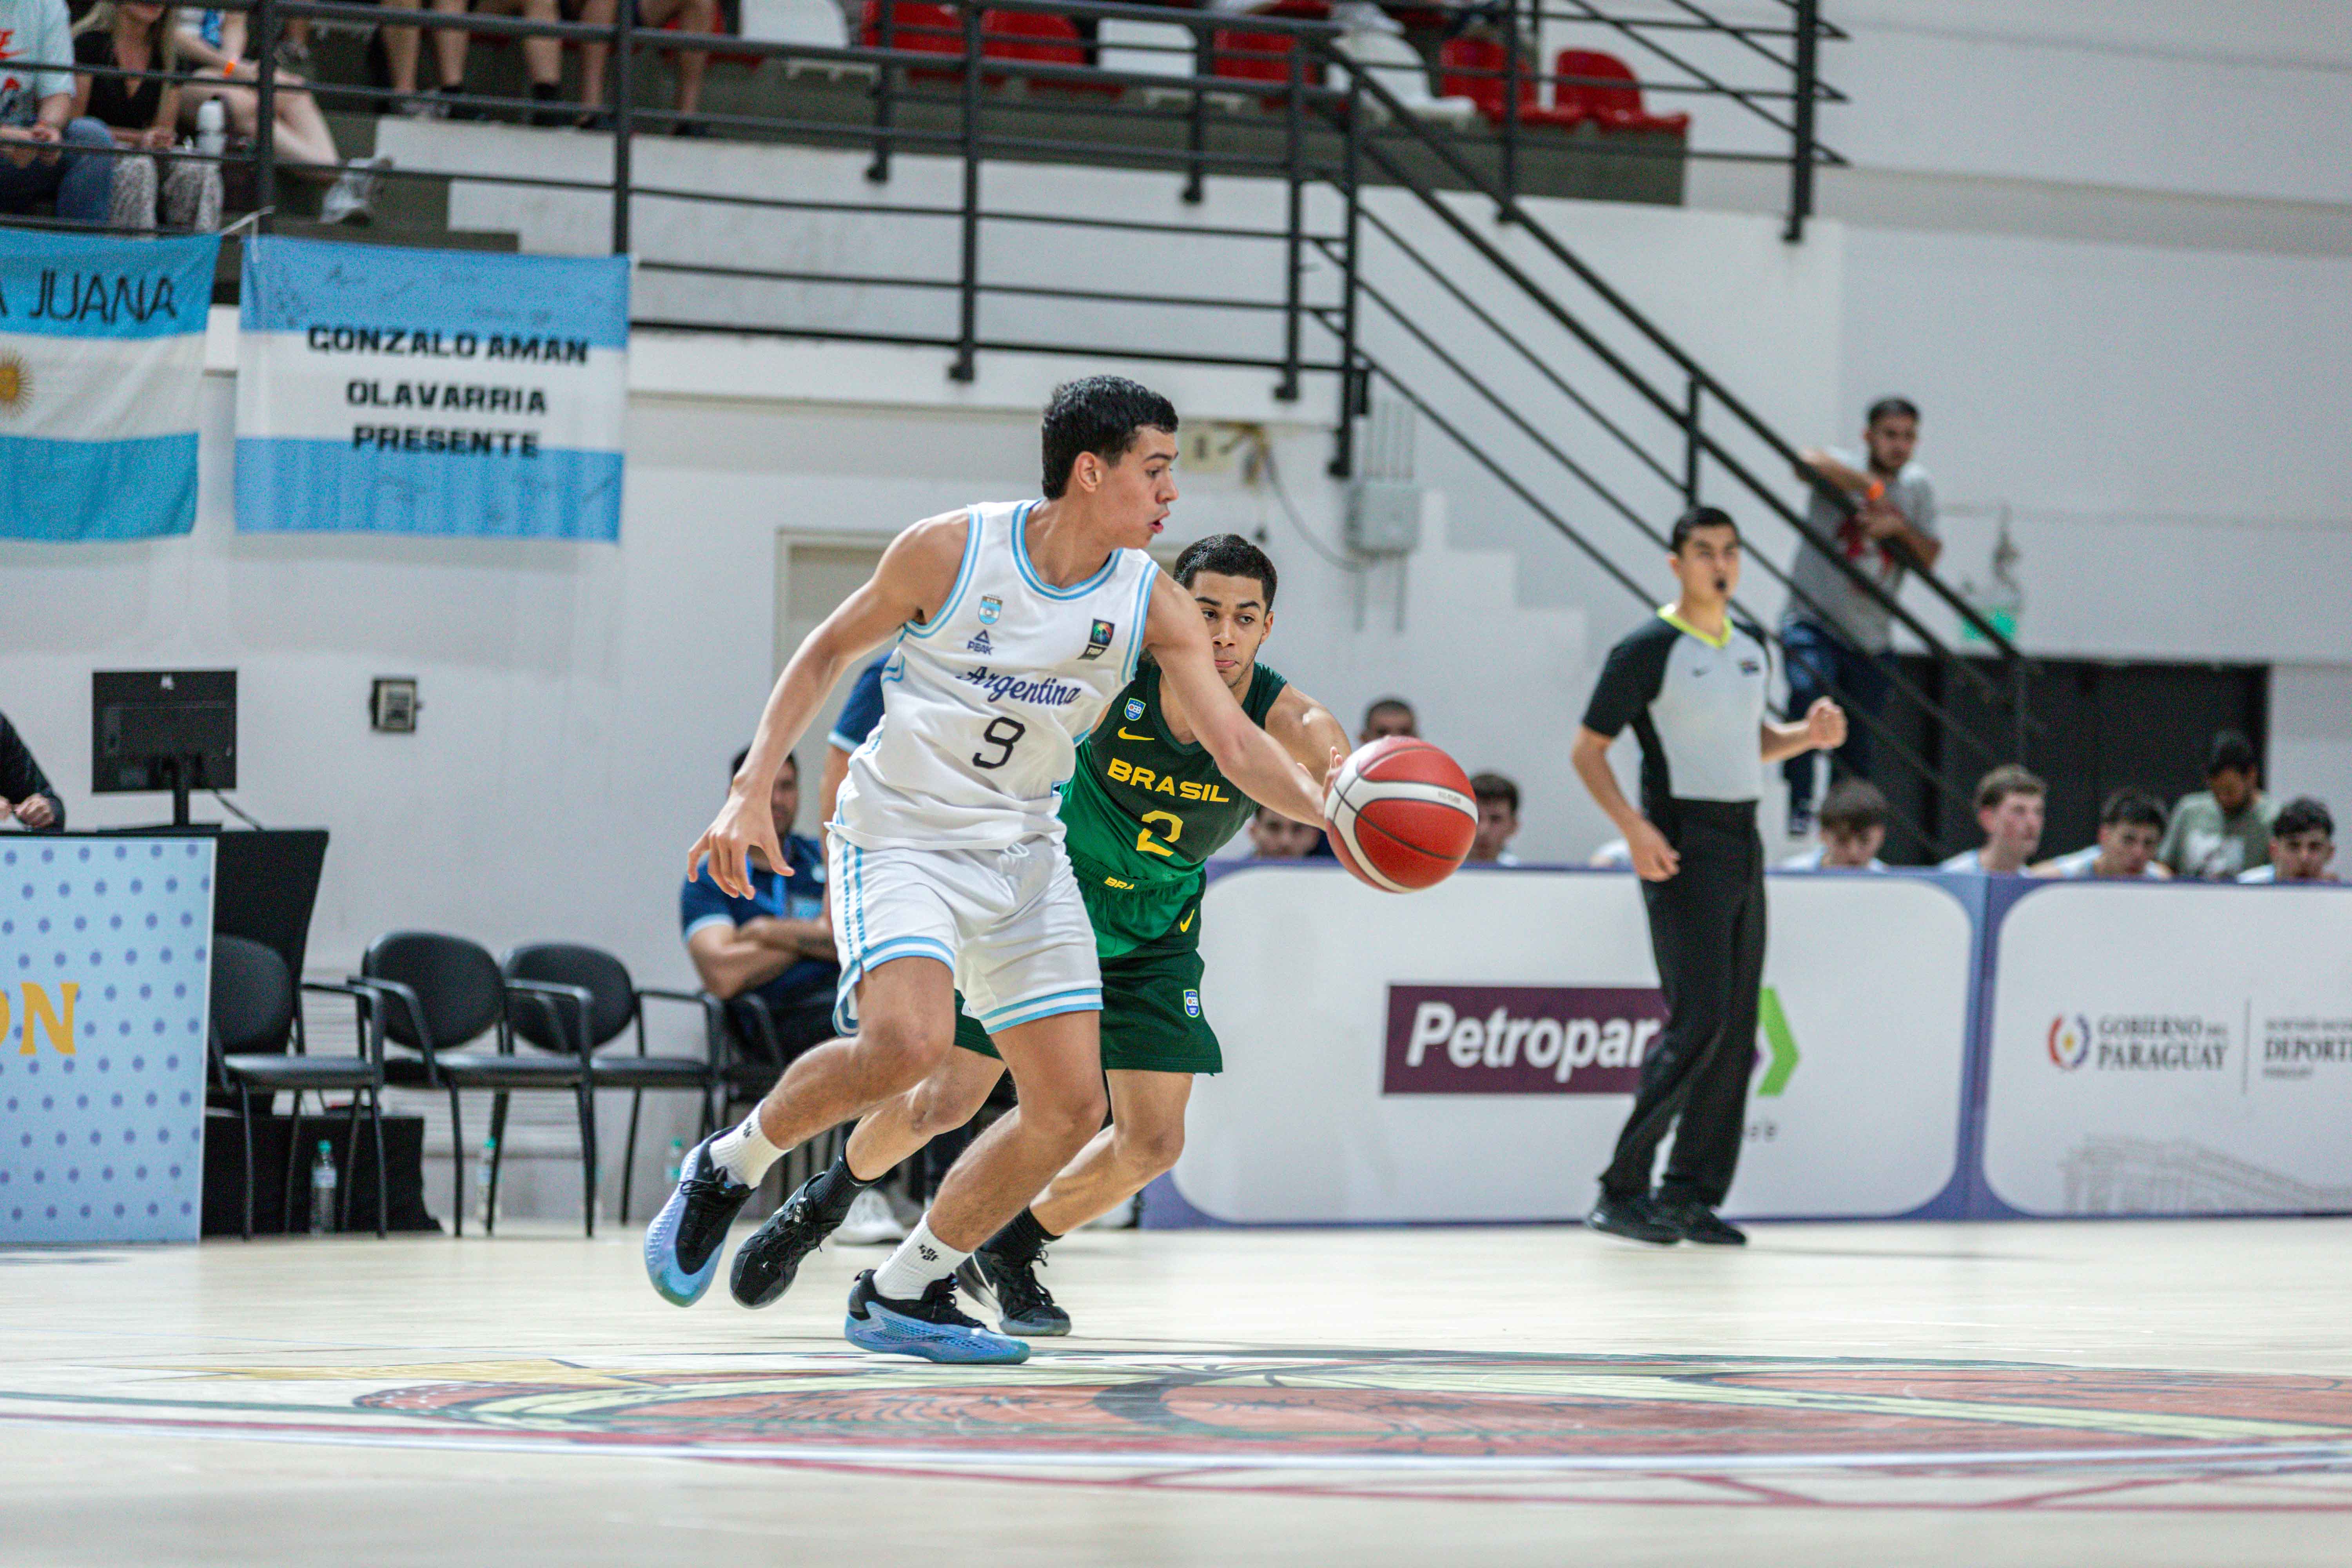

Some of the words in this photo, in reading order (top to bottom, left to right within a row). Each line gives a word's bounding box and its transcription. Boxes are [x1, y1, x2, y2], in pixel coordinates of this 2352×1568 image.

[29, 268, 178, 322] JUANA
[308, 325, 477, 358] GONZALO
[486, 332, 589, 364] AMAN
[346, 379, 546, 416] OLAVARRIA
[353, 425, 538, 458] PRESENTE
[967, 640, 995, 655] PEAK
[955, 666, 1081, 706] Argentina
[972, 717, 1025, 769] 9
[1107, 758, 1229, 802] BRASIL
[1136, 810, 1183, 857] 2
[1406, 1001, 1661, 1083] Petropar
[2097, 1041, 2229, 1071] PARAGUAY
[2264, 1038, 2352, 1062] DEPORT
